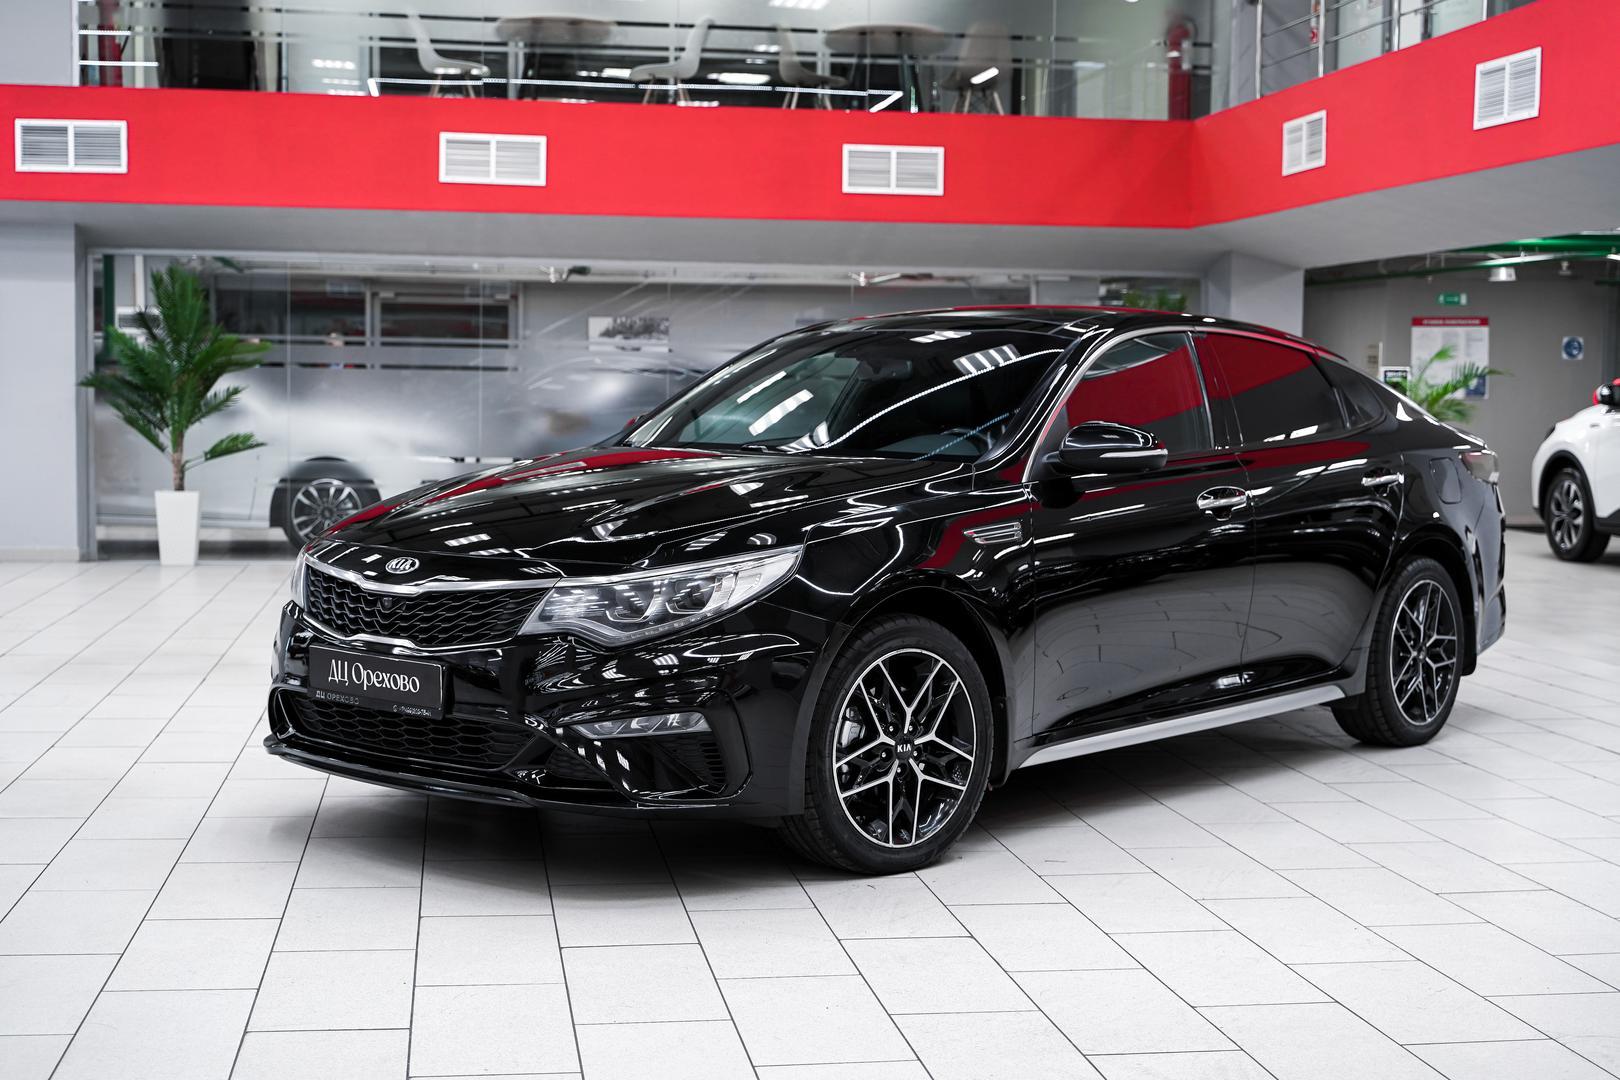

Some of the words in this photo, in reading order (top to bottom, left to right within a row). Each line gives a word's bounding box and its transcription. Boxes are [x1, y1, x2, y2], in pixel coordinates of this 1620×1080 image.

[387, 558, 414, 572] KIA
[328, 659, 349, 686] ДЦ
[351, 662, 420, 693] Орехово
[315, 690, 325, 699] ДЦ
[326, 692, 360, 705] ОРЕХОВО
[897, 743, 912, 753] KIA
